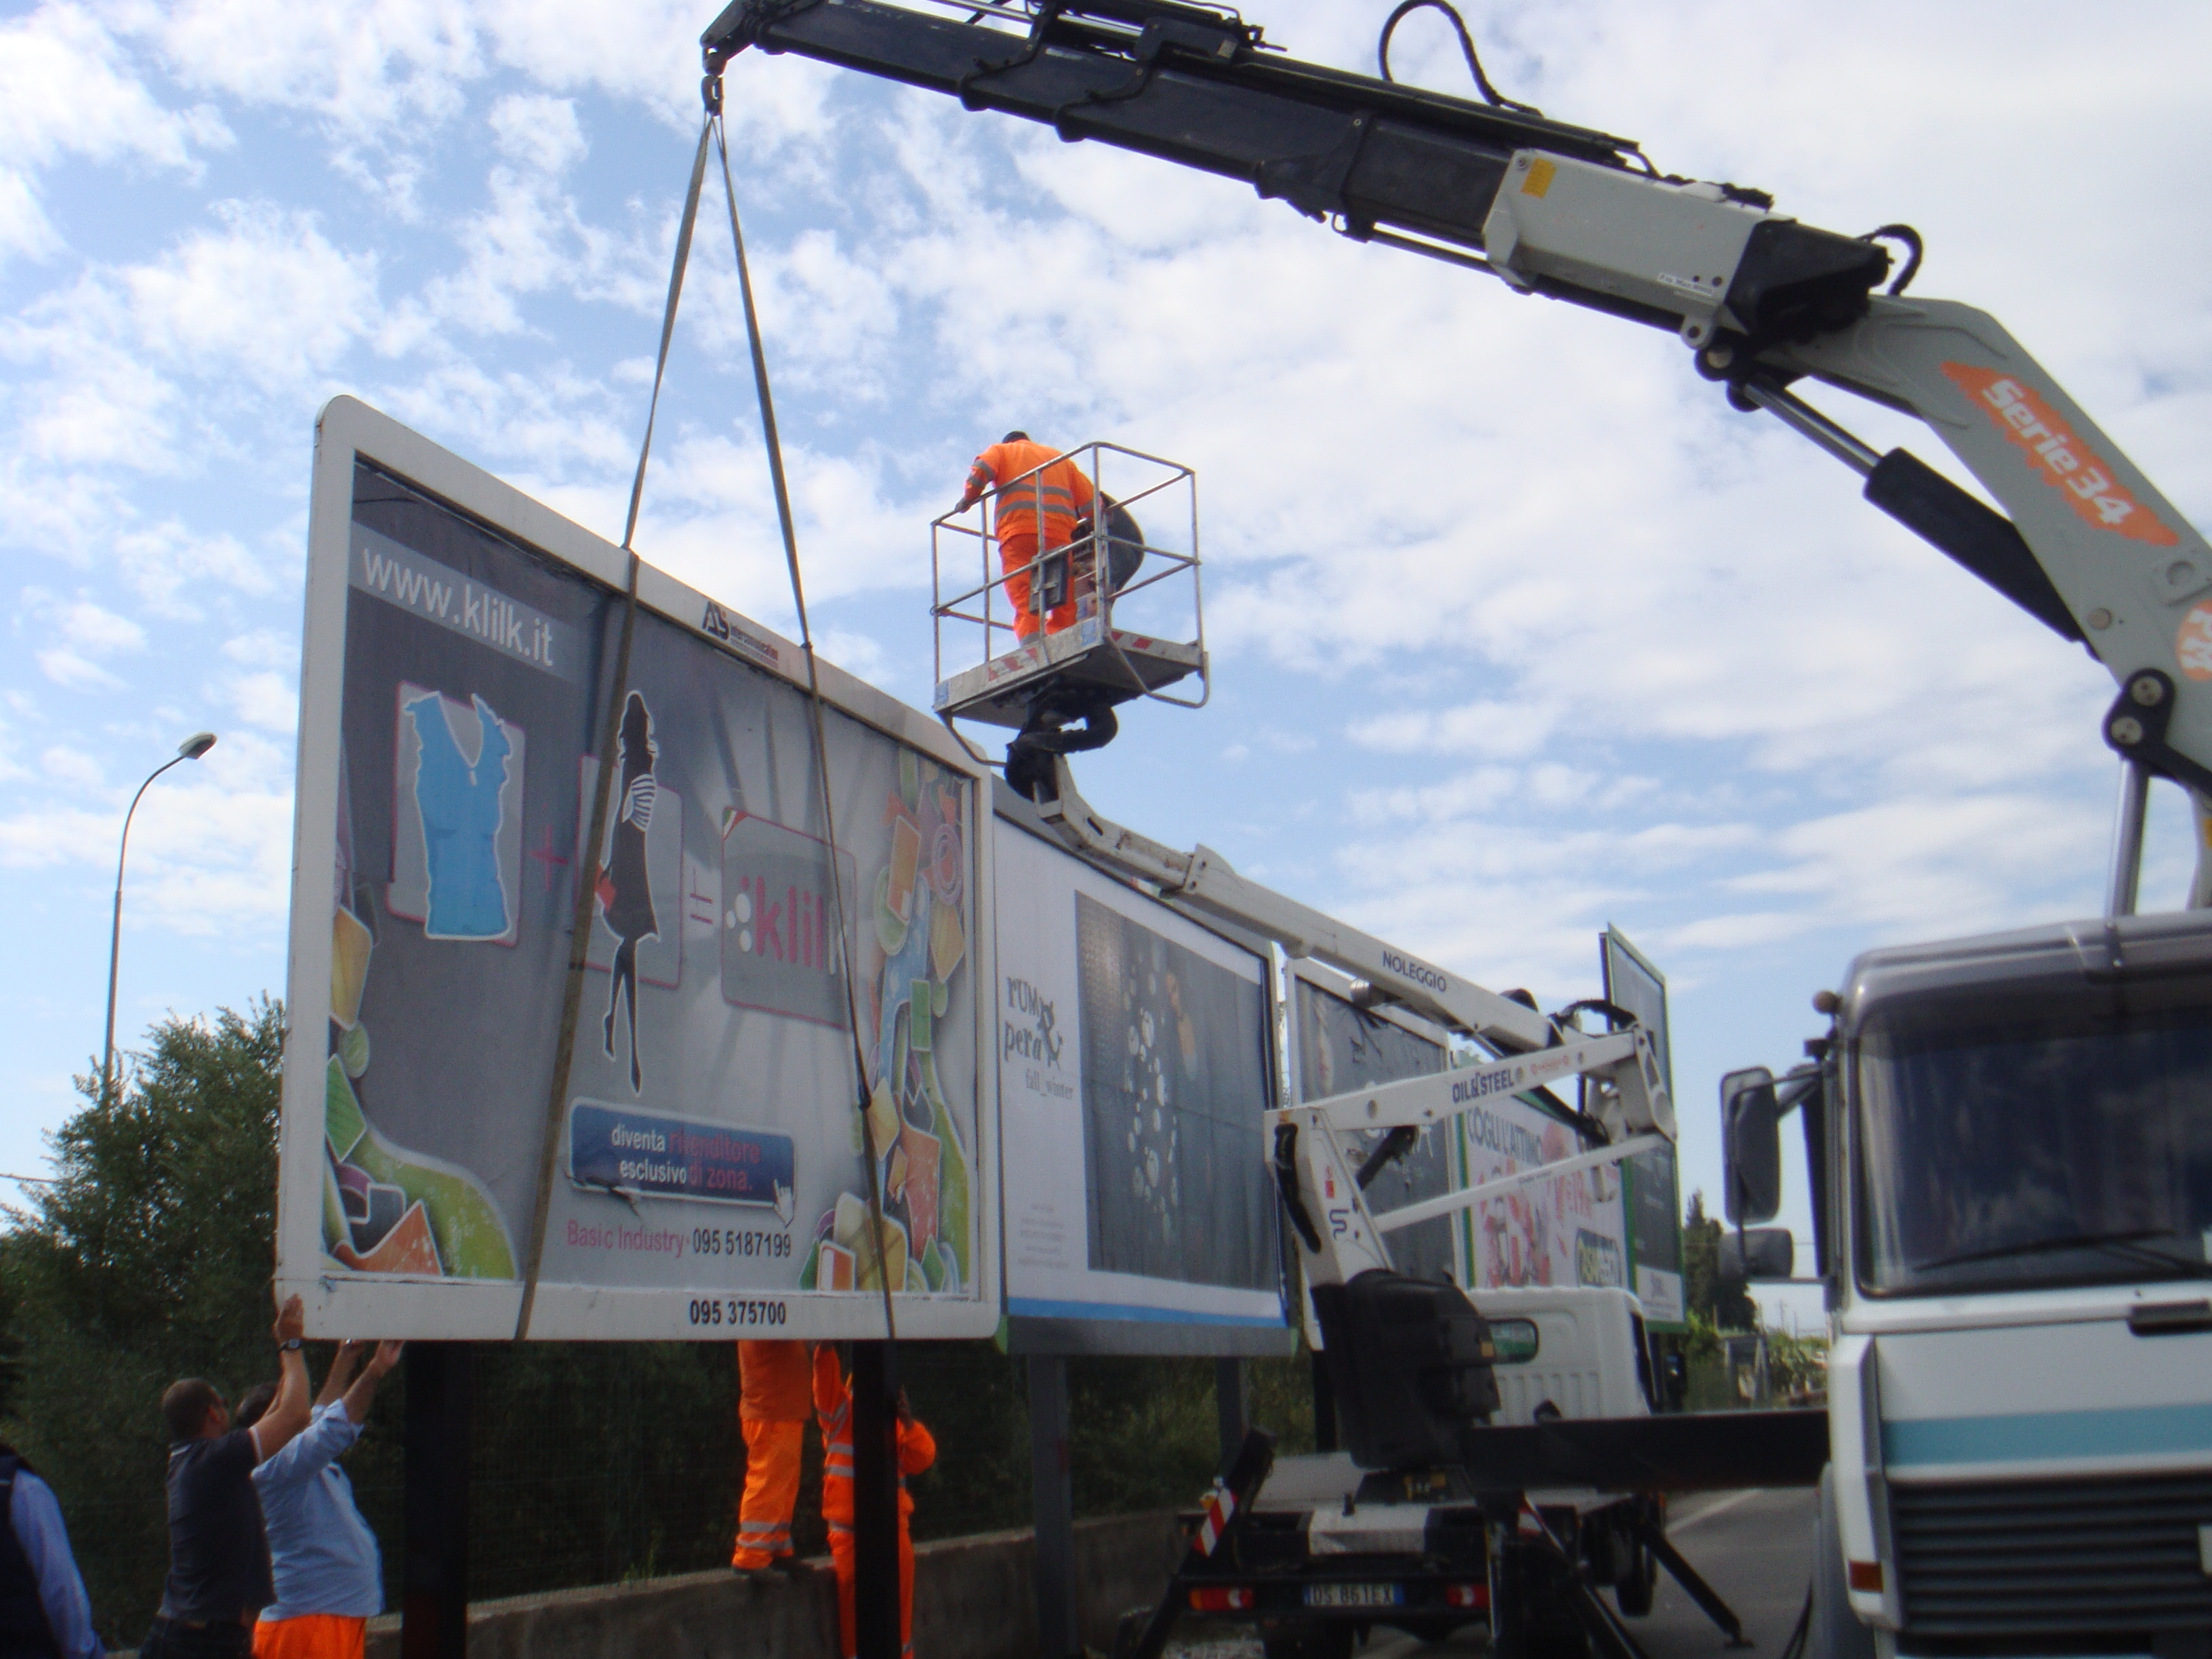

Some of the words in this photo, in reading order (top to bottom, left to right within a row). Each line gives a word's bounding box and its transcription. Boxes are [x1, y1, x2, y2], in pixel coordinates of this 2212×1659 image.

[1982, 380, 2078, 475] Serie
[2067, 466, 2133, 525] 34
[363, 548, 553, 667] www.klilk.it
[1382, 950, 1447, 993] NOLEGGIO
[1004, 1019, 1042, 1063] pera
[611, 1123, 666, 1153] diventa
[619, 1158, 687, 1185] esclusivo
[567, 1220, 613, 1249] Basic
[693, 1227, 720, 1255] 095
[725, 1230, 792, 1258] 5187199
[689, 1299, 722, 1325] 095
[728, 1300, 787, 1325] 375700
